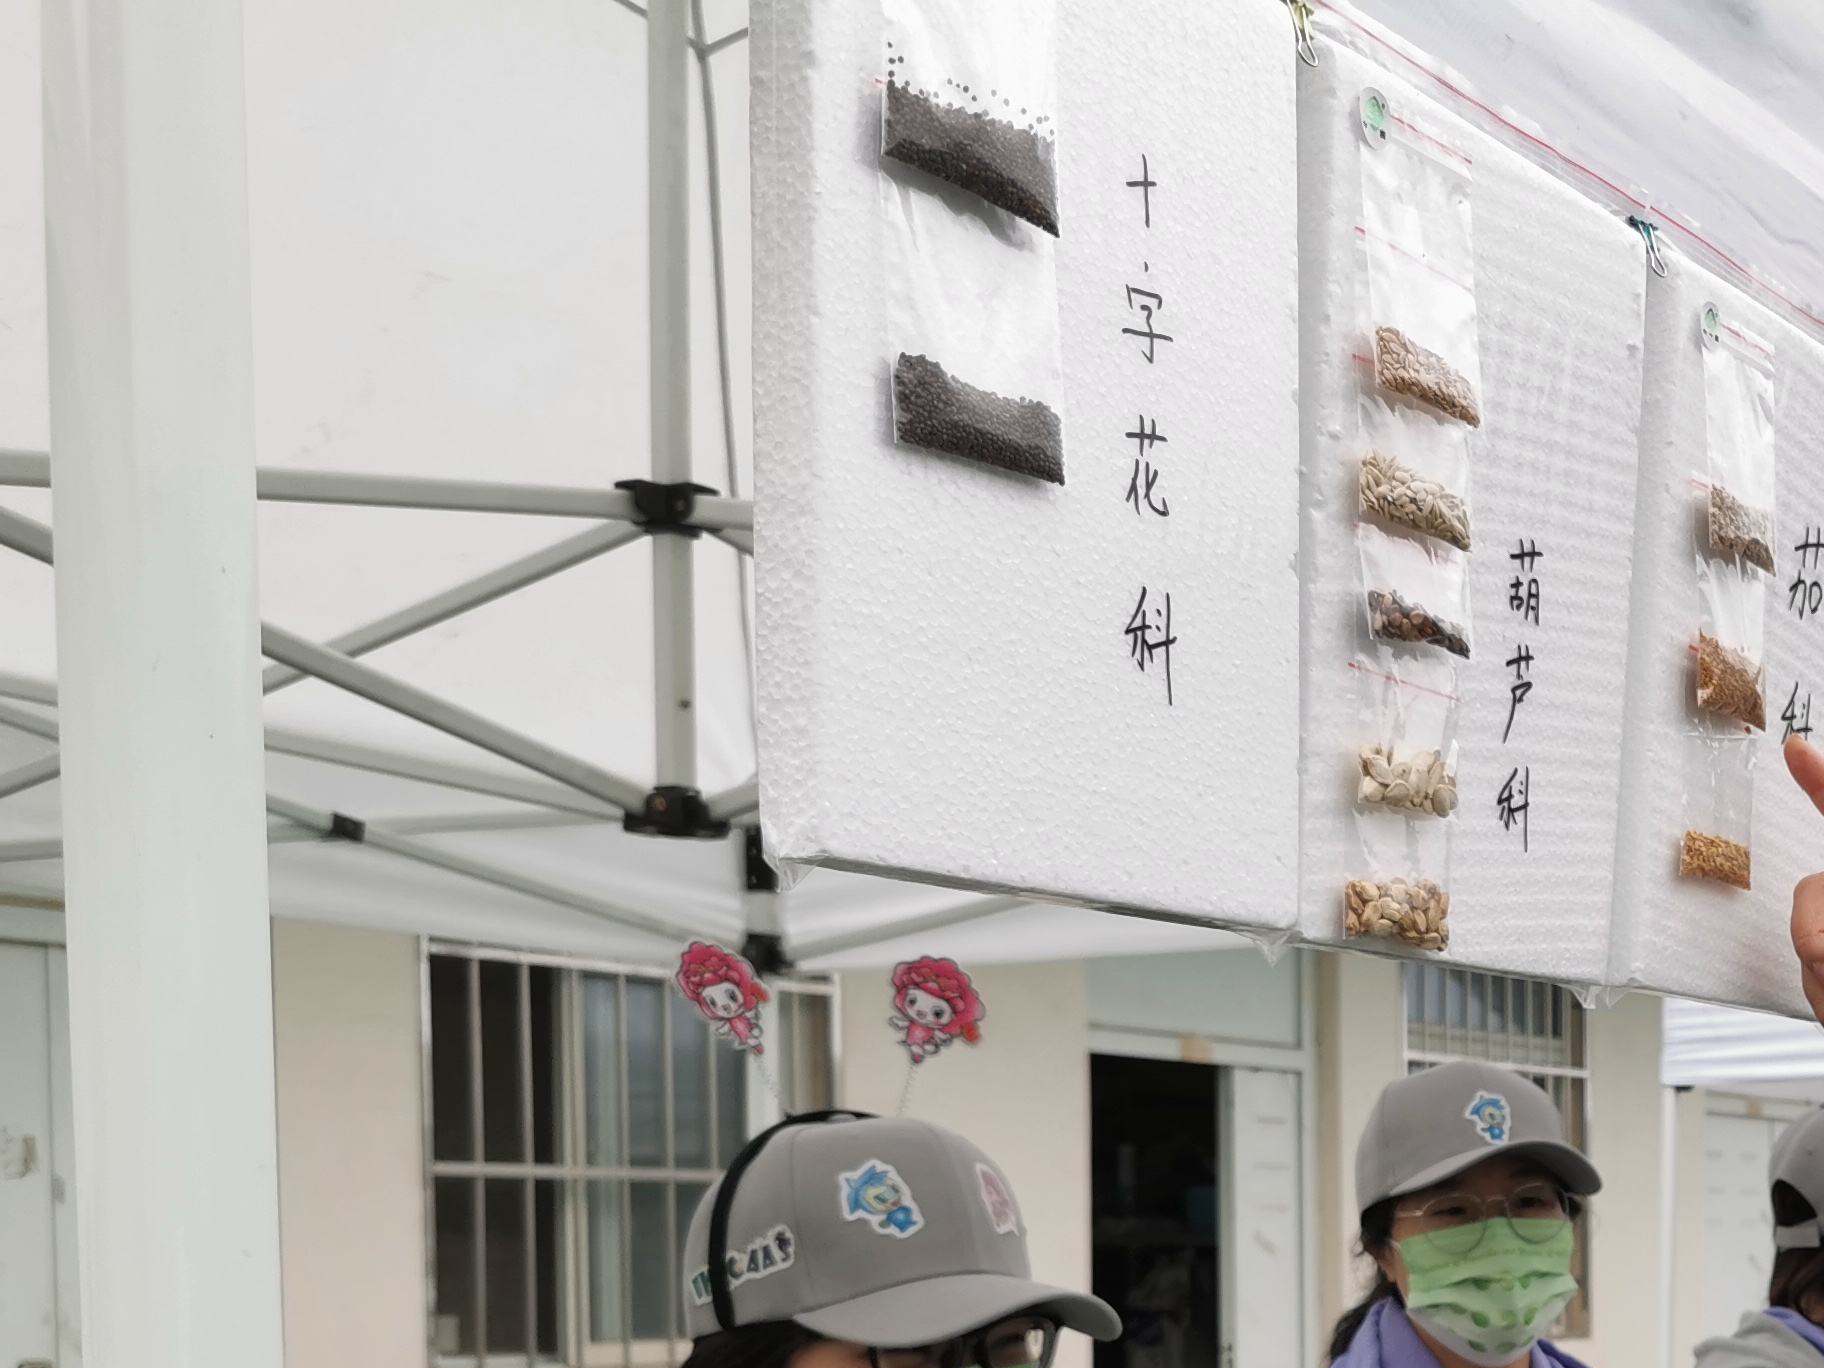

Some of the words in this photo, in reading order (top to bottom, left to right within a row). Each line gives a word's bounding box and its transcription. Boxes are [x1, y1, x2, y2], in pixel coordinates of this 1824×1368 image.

[1122, 154, 1178, 706] 十字花科
[1496, 538, 1545, 853] 葫芦科
